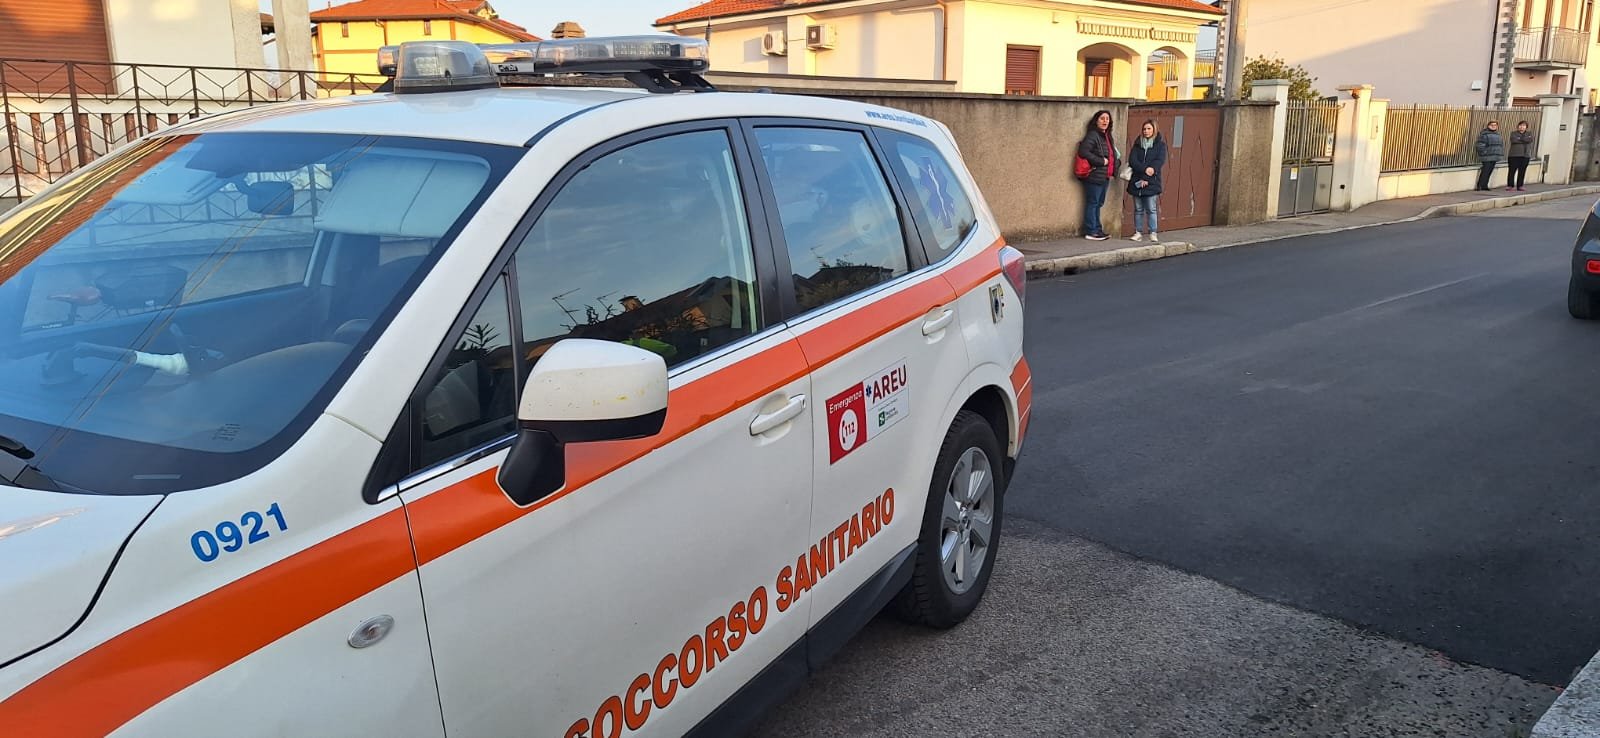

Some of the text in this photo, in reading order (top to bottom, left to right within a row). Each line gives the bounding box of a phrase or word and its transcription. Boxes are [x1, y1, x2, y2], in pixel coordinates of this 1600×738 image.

[829, 390, 863, 414] Emergenza
[872, 364, 907, 404] AREU
[844, 421, 856, 437] 112
[190, 502, 288, 562] 0921
[776, 487, 895, 612] SANITARIO
